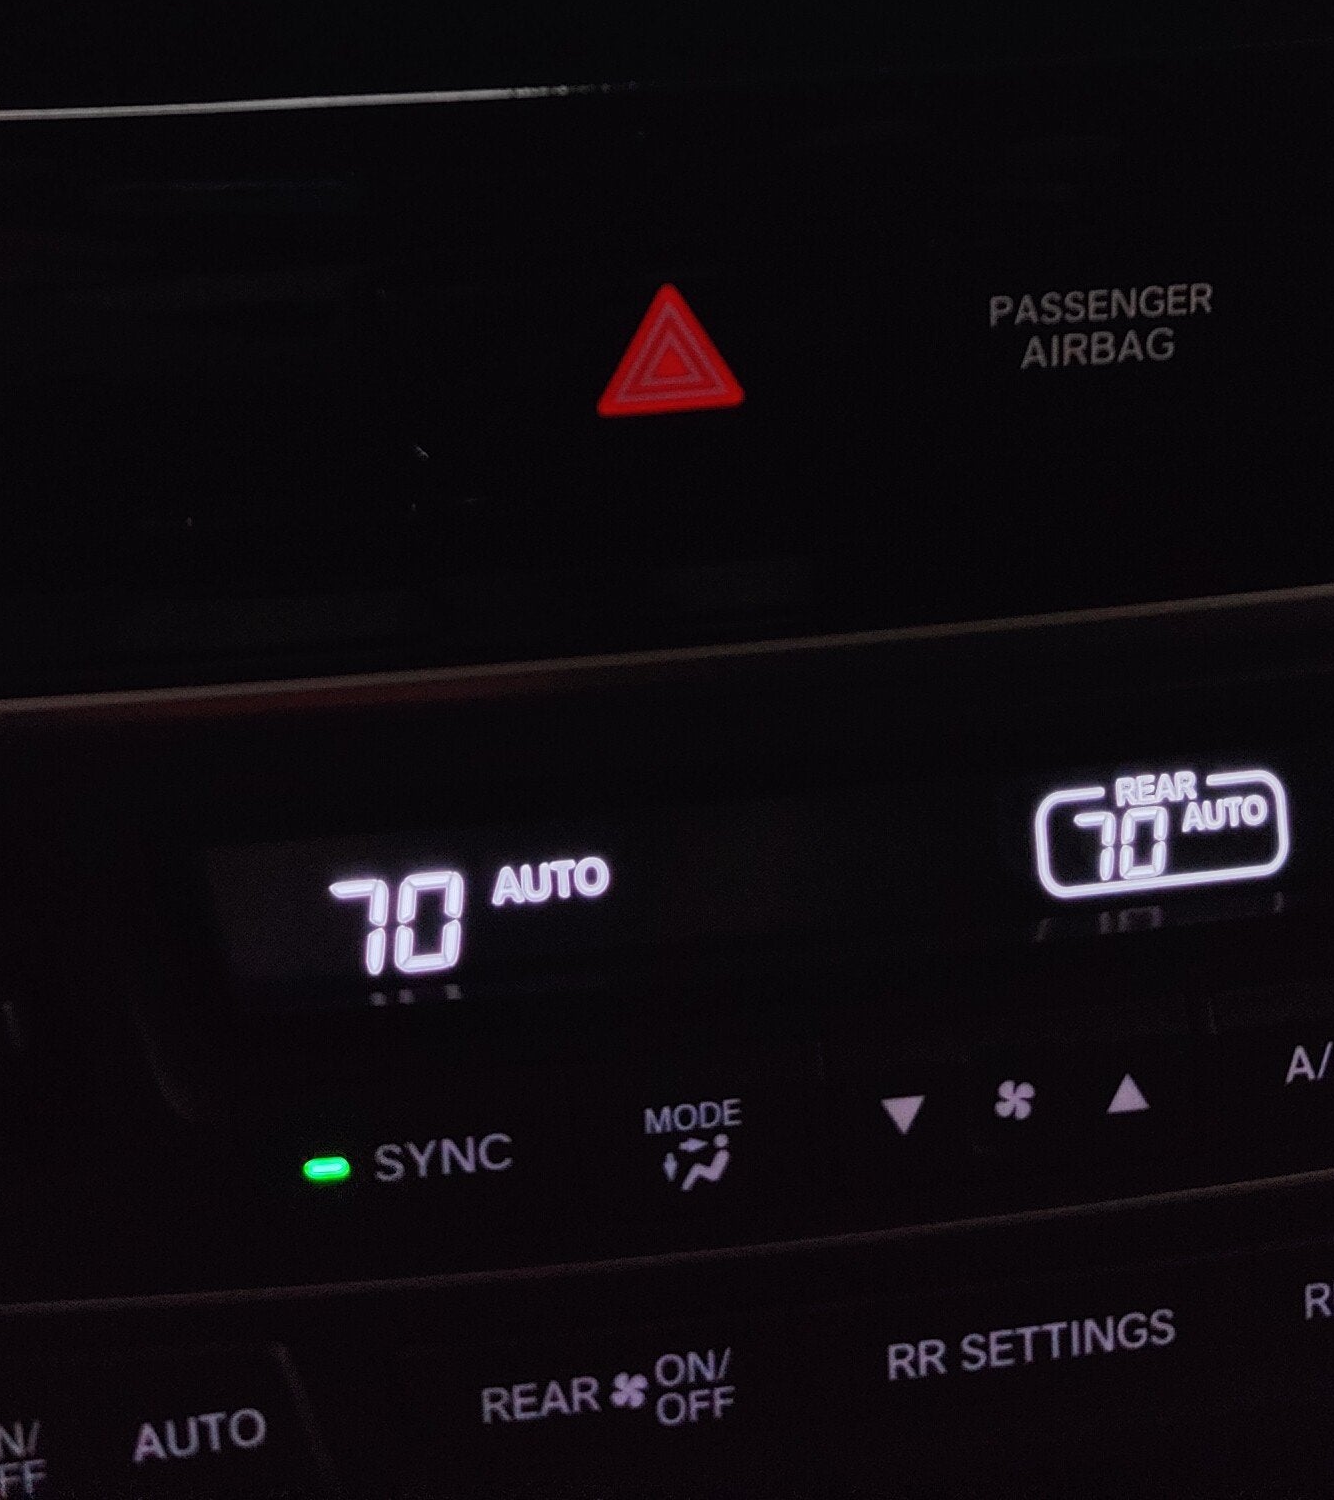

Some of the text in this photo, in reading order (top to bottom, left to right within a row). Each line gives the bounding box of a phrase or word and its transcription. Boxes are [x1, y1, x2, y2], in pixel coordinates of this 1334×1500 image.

[988, 282, 1214, 328] PASSENGER
[1019, 327, 1176, 370] AIRBAG
[1114, 770, 1198, 807] REAR
[1073, 794, 1269, 882] 70 AUTO
[490, 856, 610, 906] AUTO
[327, 869, 465, 977] 70
[643, 1097, 741, 1135] MODE
[373, 1132, 514, 1183] SYNC
[886, 1307, 1178, 1382] RR SETTINGS
[480, 1346, 733, 1425] REAR ON/
[654, 1385, 736, 1426] OFF
[131, 1407, 268, 1463] AUTO
